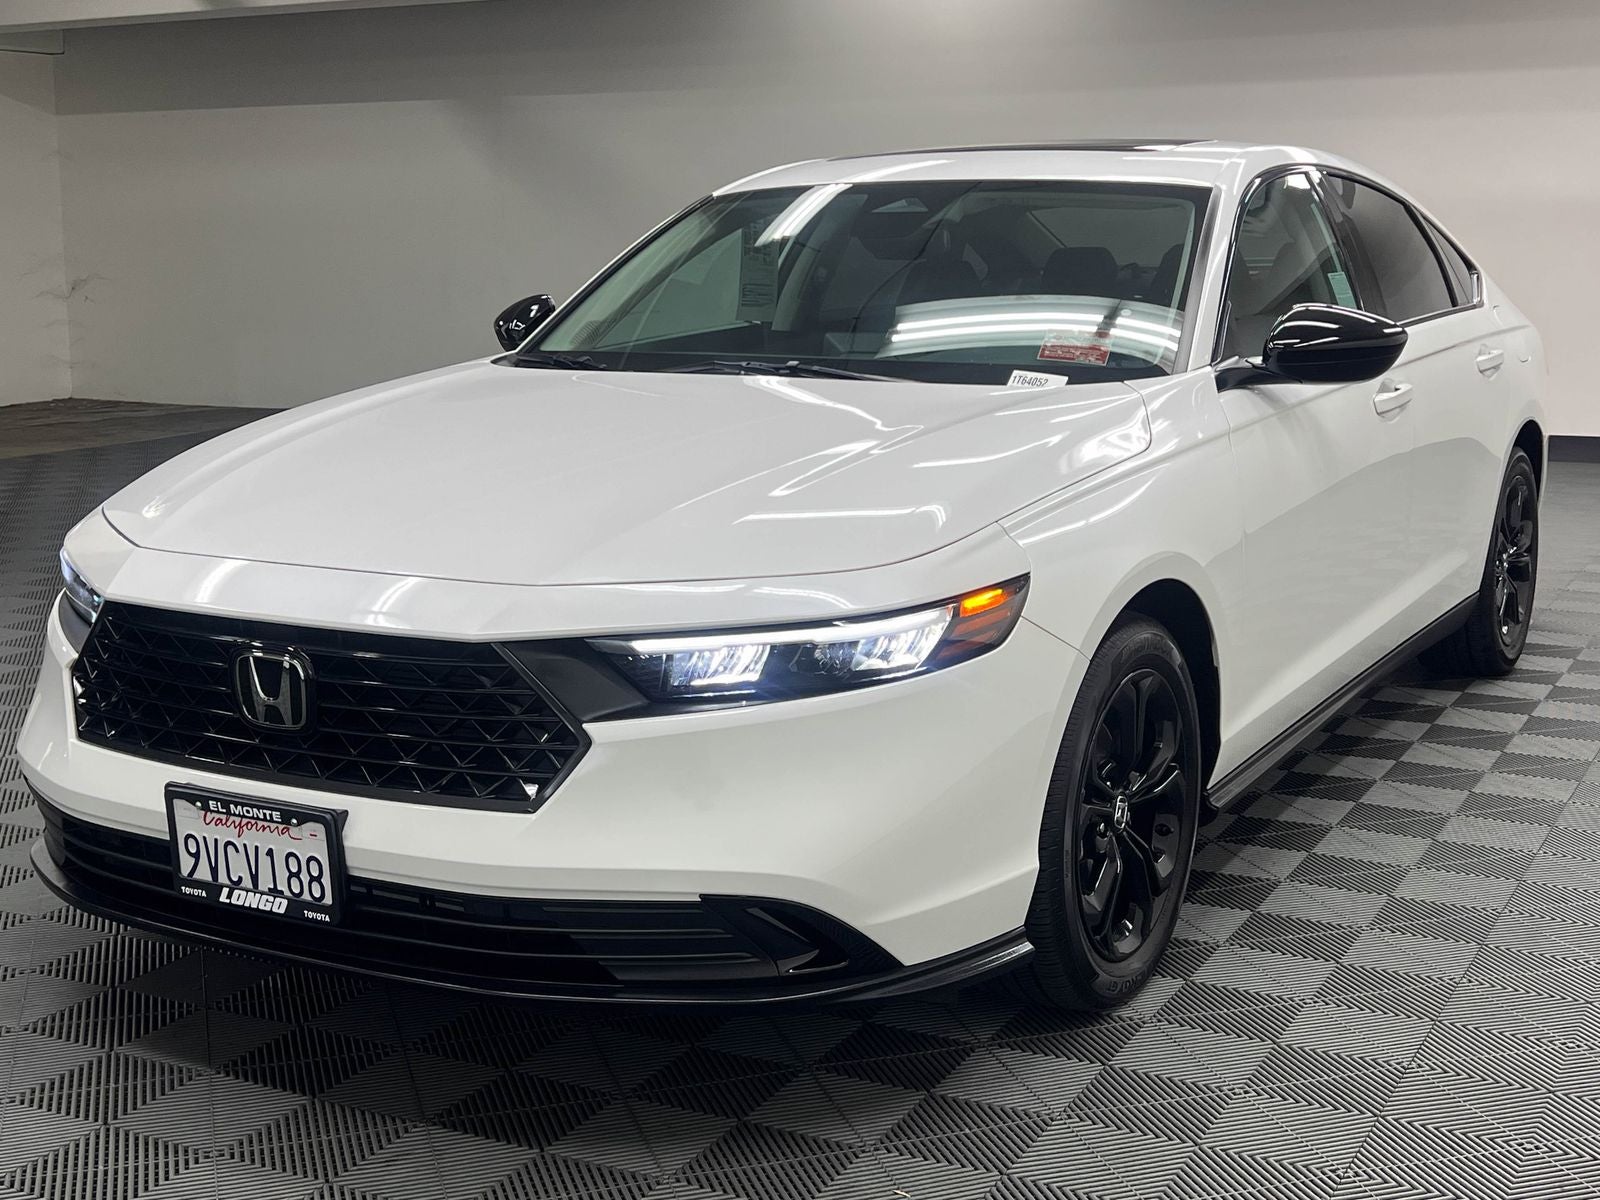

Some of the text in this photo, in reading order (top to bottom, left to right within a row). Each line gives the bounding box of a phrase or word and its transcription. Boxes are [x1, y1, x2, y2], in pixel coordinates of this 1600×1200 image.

[208, 800, 282, 822] EL MONTE
[203, 811, 303, 840] California
[184, 833, 326, 903] 9VCV188
[181, 886, 207, 898] TOYOTA
[219, 887, 288, 914] LONGO
[303, 910, 331, 922] TOYOTA
